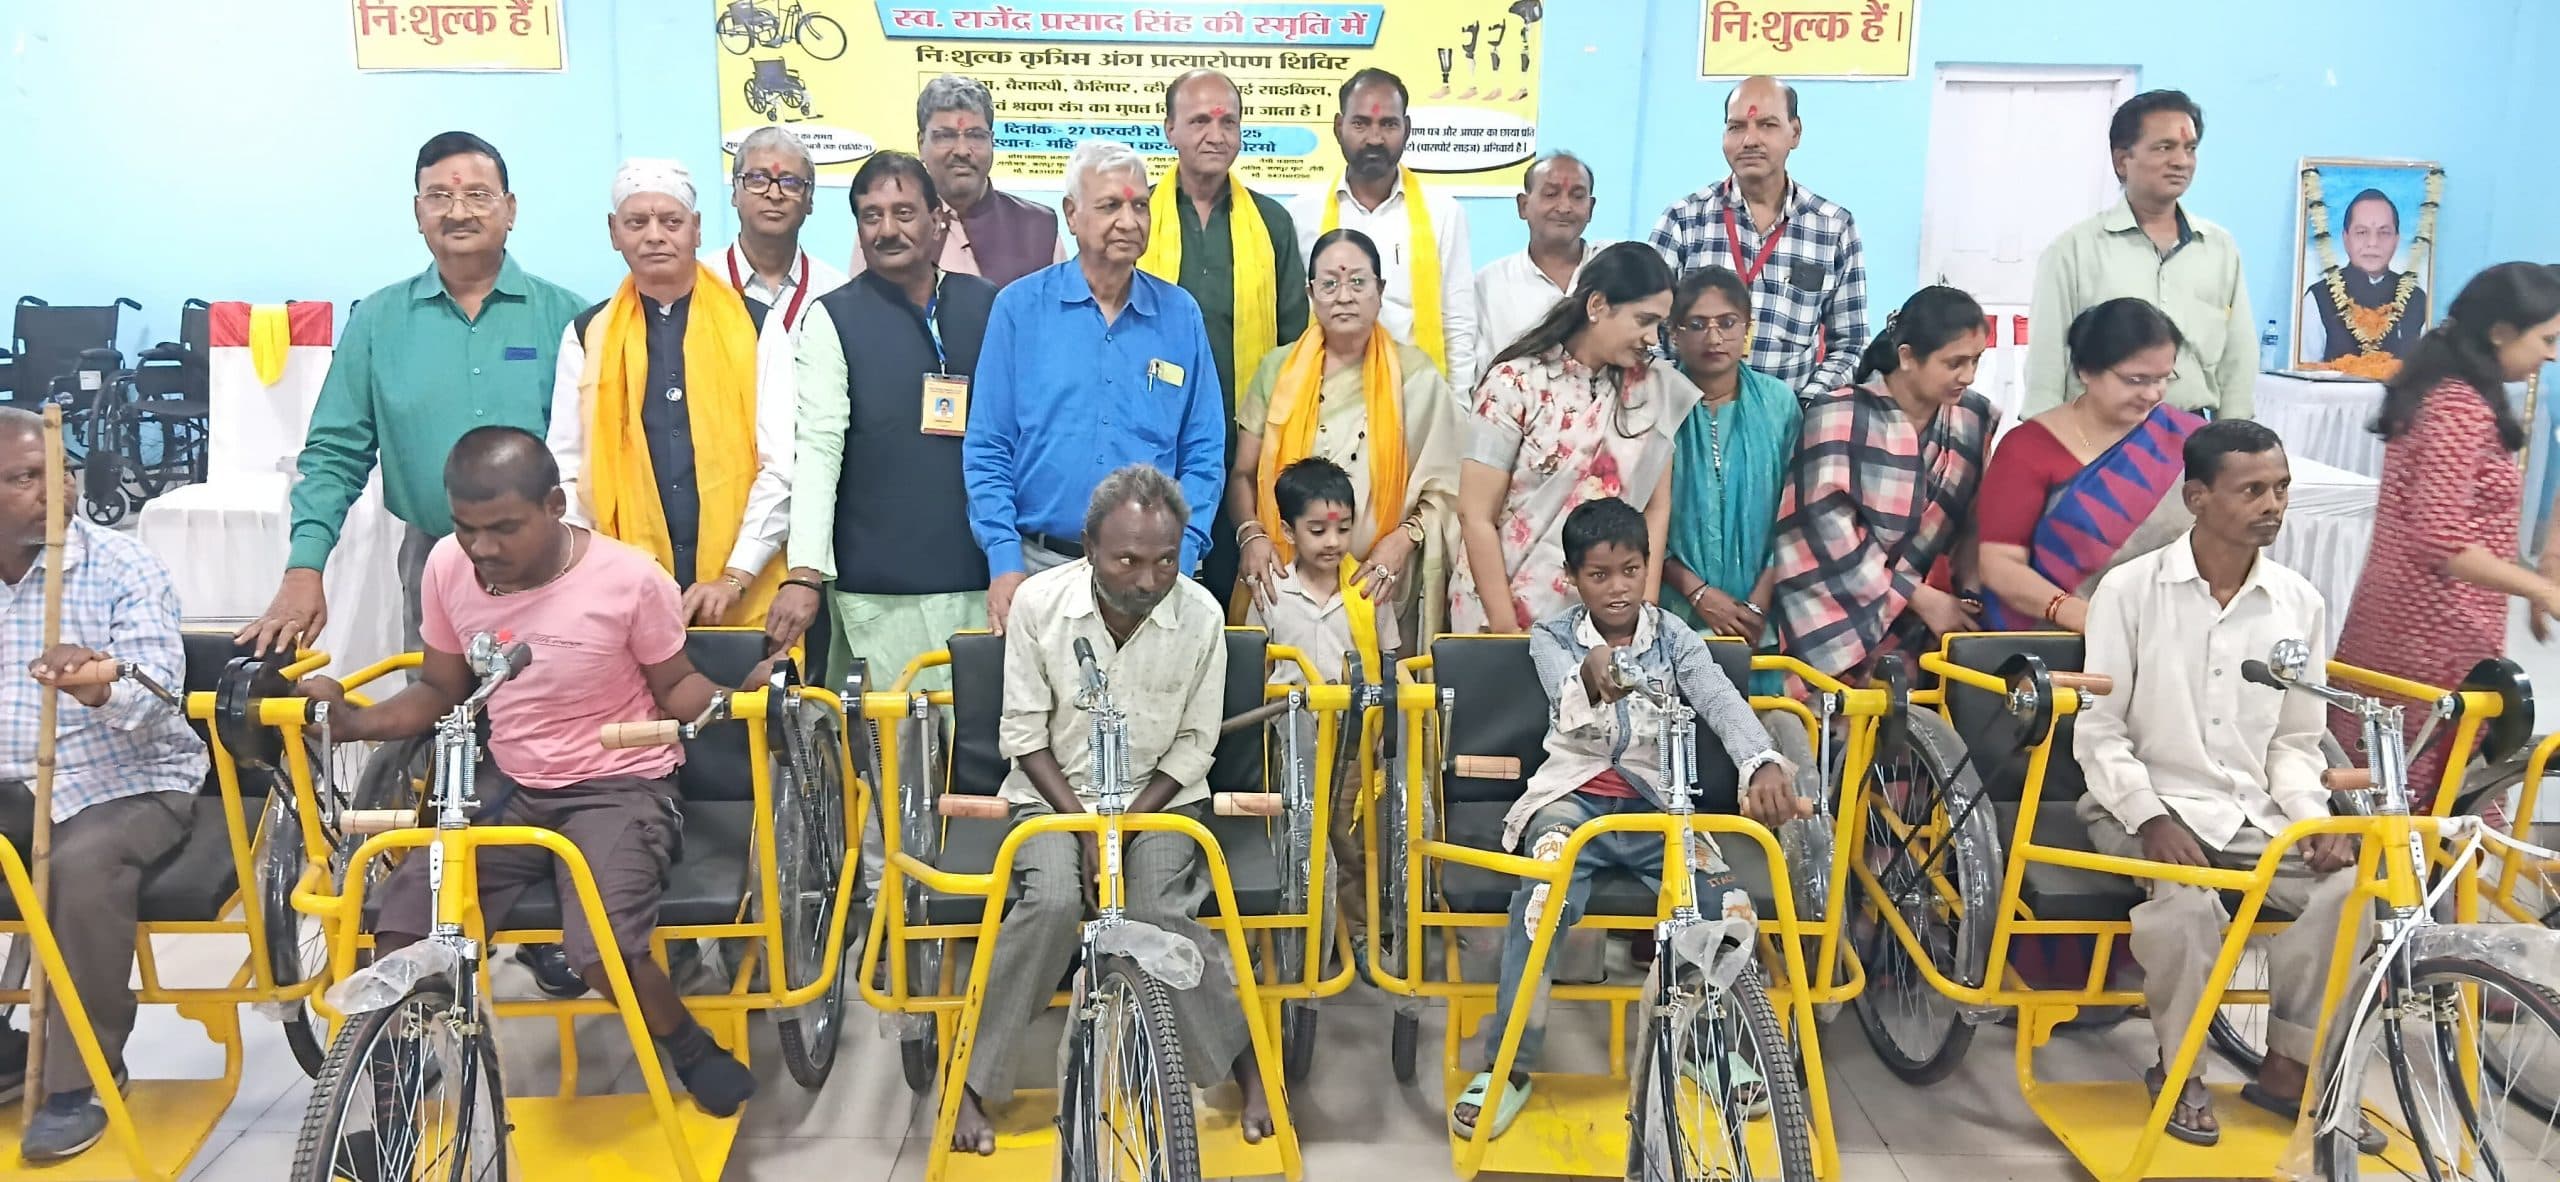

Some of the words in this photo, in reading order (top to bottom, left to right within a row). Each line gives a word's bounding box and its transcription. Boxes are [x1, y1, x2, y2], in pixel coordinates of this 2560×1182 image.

[893, 9, 943, 28] स्व.
[953, 5, 1032, 31] राजेंद्र
[1041, 13, 1123, 32] प्रसाद
[1135, 10, 1192, 33] सिंह
[1254, 13, 1330, 40] स्मृति
[1341, 13, 1369, 35] में
[1019, 48, 1090, 70] कृत्रिम
[1098, 50, 1143, 67] अंग
[1151, 51, 1272, 70] प्रत्यारोपण
[1280, 52, 1350, 71] शिविर
[1088, 103, 1110, 114] का
[1259, 106, 1296, 116] जाता
[1068, 126, 1085, 136] 27
[1146, 125, 1161, 138] से
[1242, 129, 1262, 139] 25
